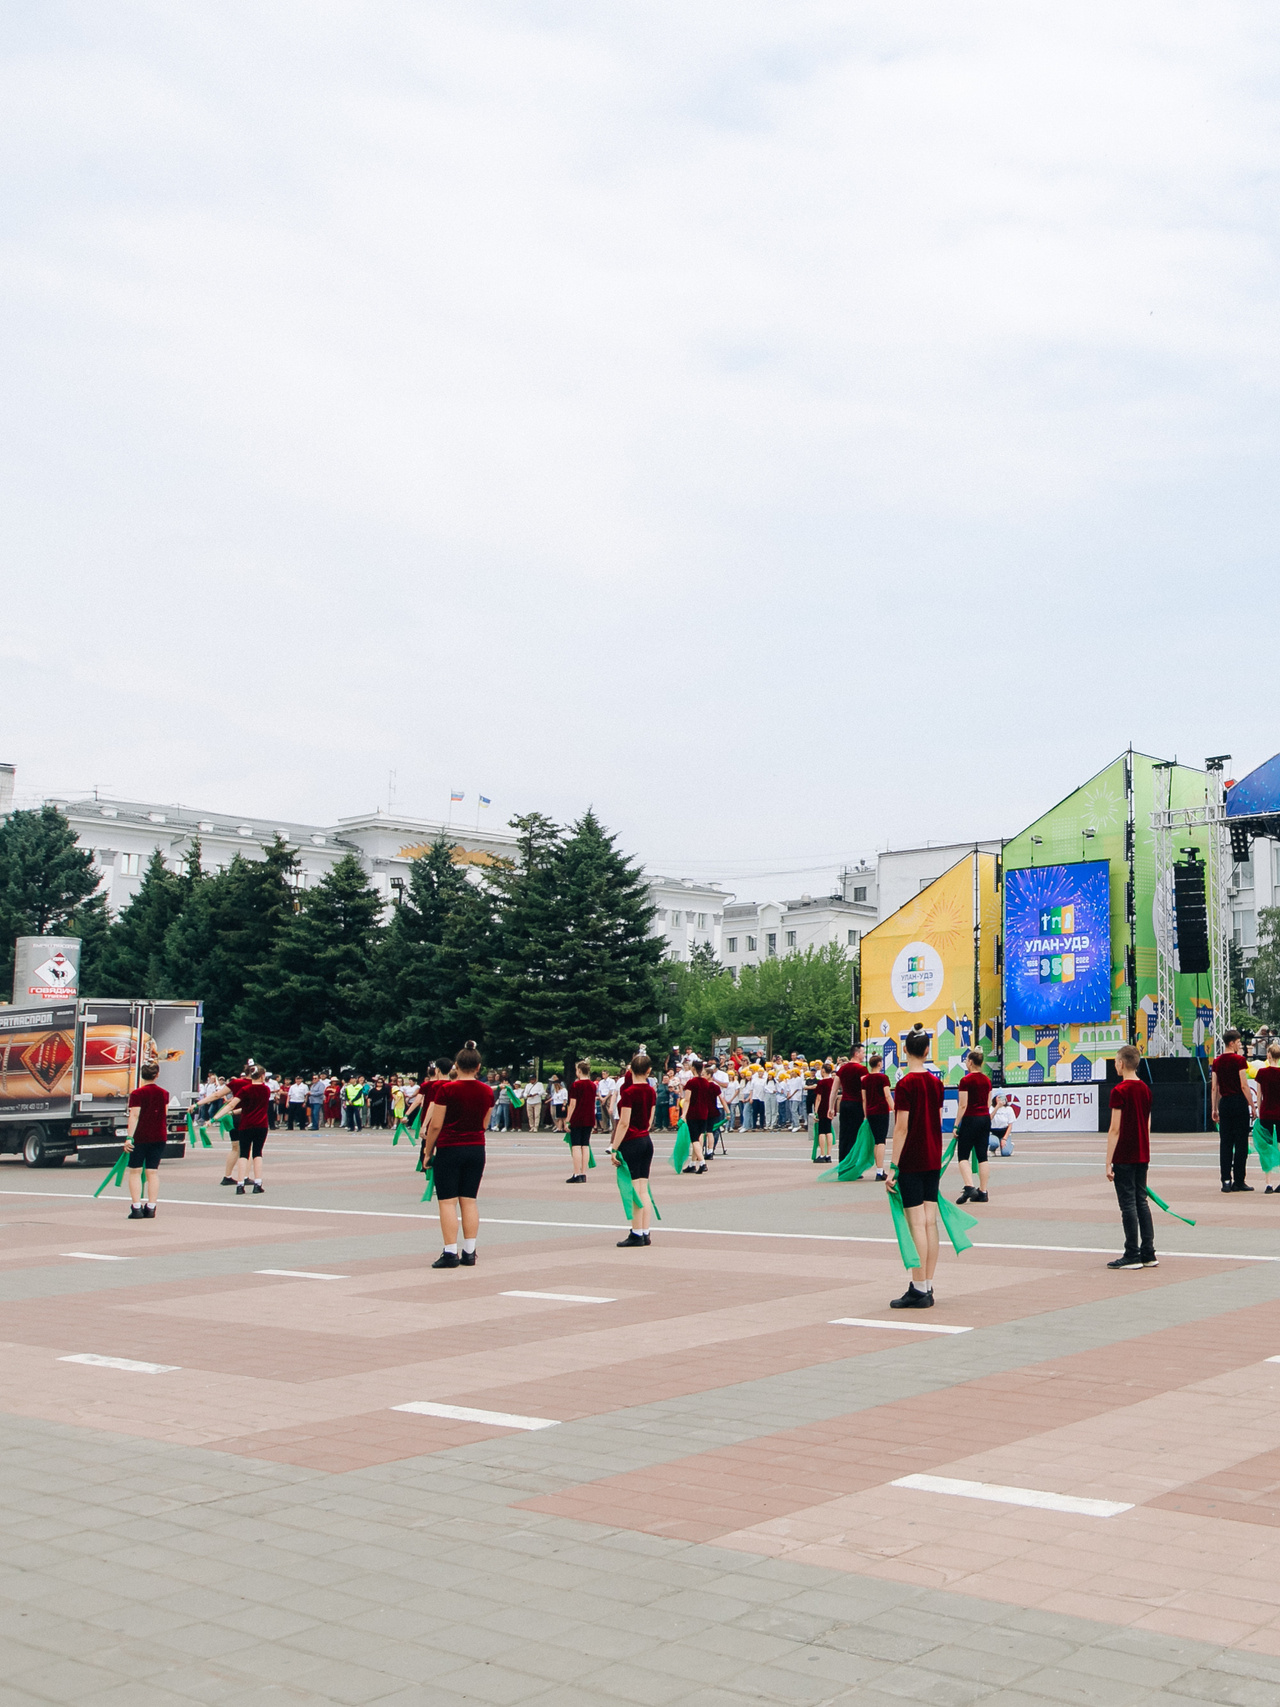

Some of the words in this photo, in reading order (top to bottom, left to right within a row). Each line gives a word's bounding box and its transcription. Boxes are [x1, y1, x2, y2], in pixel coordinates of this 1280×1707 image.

[1024, 936, 1090, 953] УЛАН-УДЭ
[1040, 957, 1075, 977] 356
[900, 971, 934, 981] УЛАН-УДЭ
[30, 987, 77, 995] ГОВЯДИНА
[1026, 1092, 1093, 1106] ВЕРТОЛЕТЫ
[1026, 1108, 1071, 1120] РОССИИ
